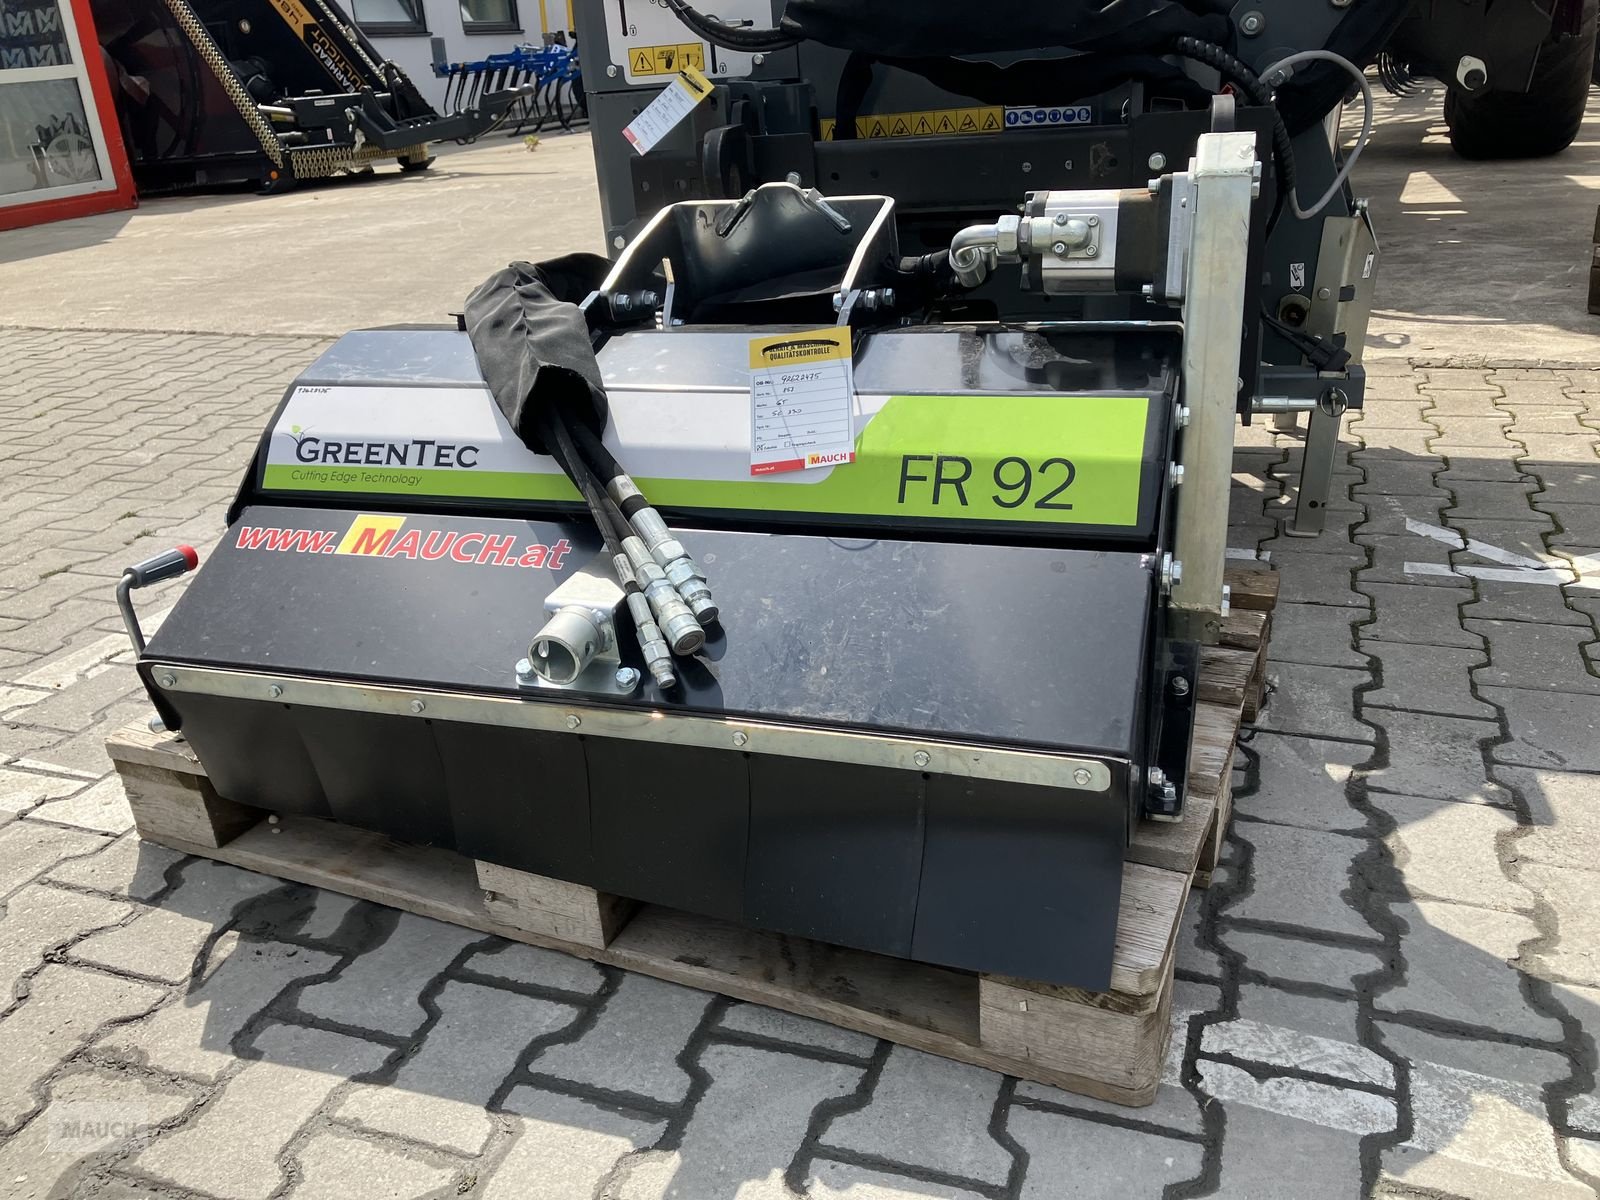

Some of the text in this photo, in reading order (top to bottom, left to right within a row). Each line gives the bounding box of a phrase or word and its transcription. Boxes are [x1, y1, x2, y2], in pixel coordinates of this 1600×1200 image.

[312, 42, 356, 94] EARHEAD
[291, 469, 423, 486] Cutting Edge Technology
[811, 453, 847, 464] MAUCH
[897, 454, 1076, 510] FR 92
[235, 525, 573, 571] www.MAUCH.at
